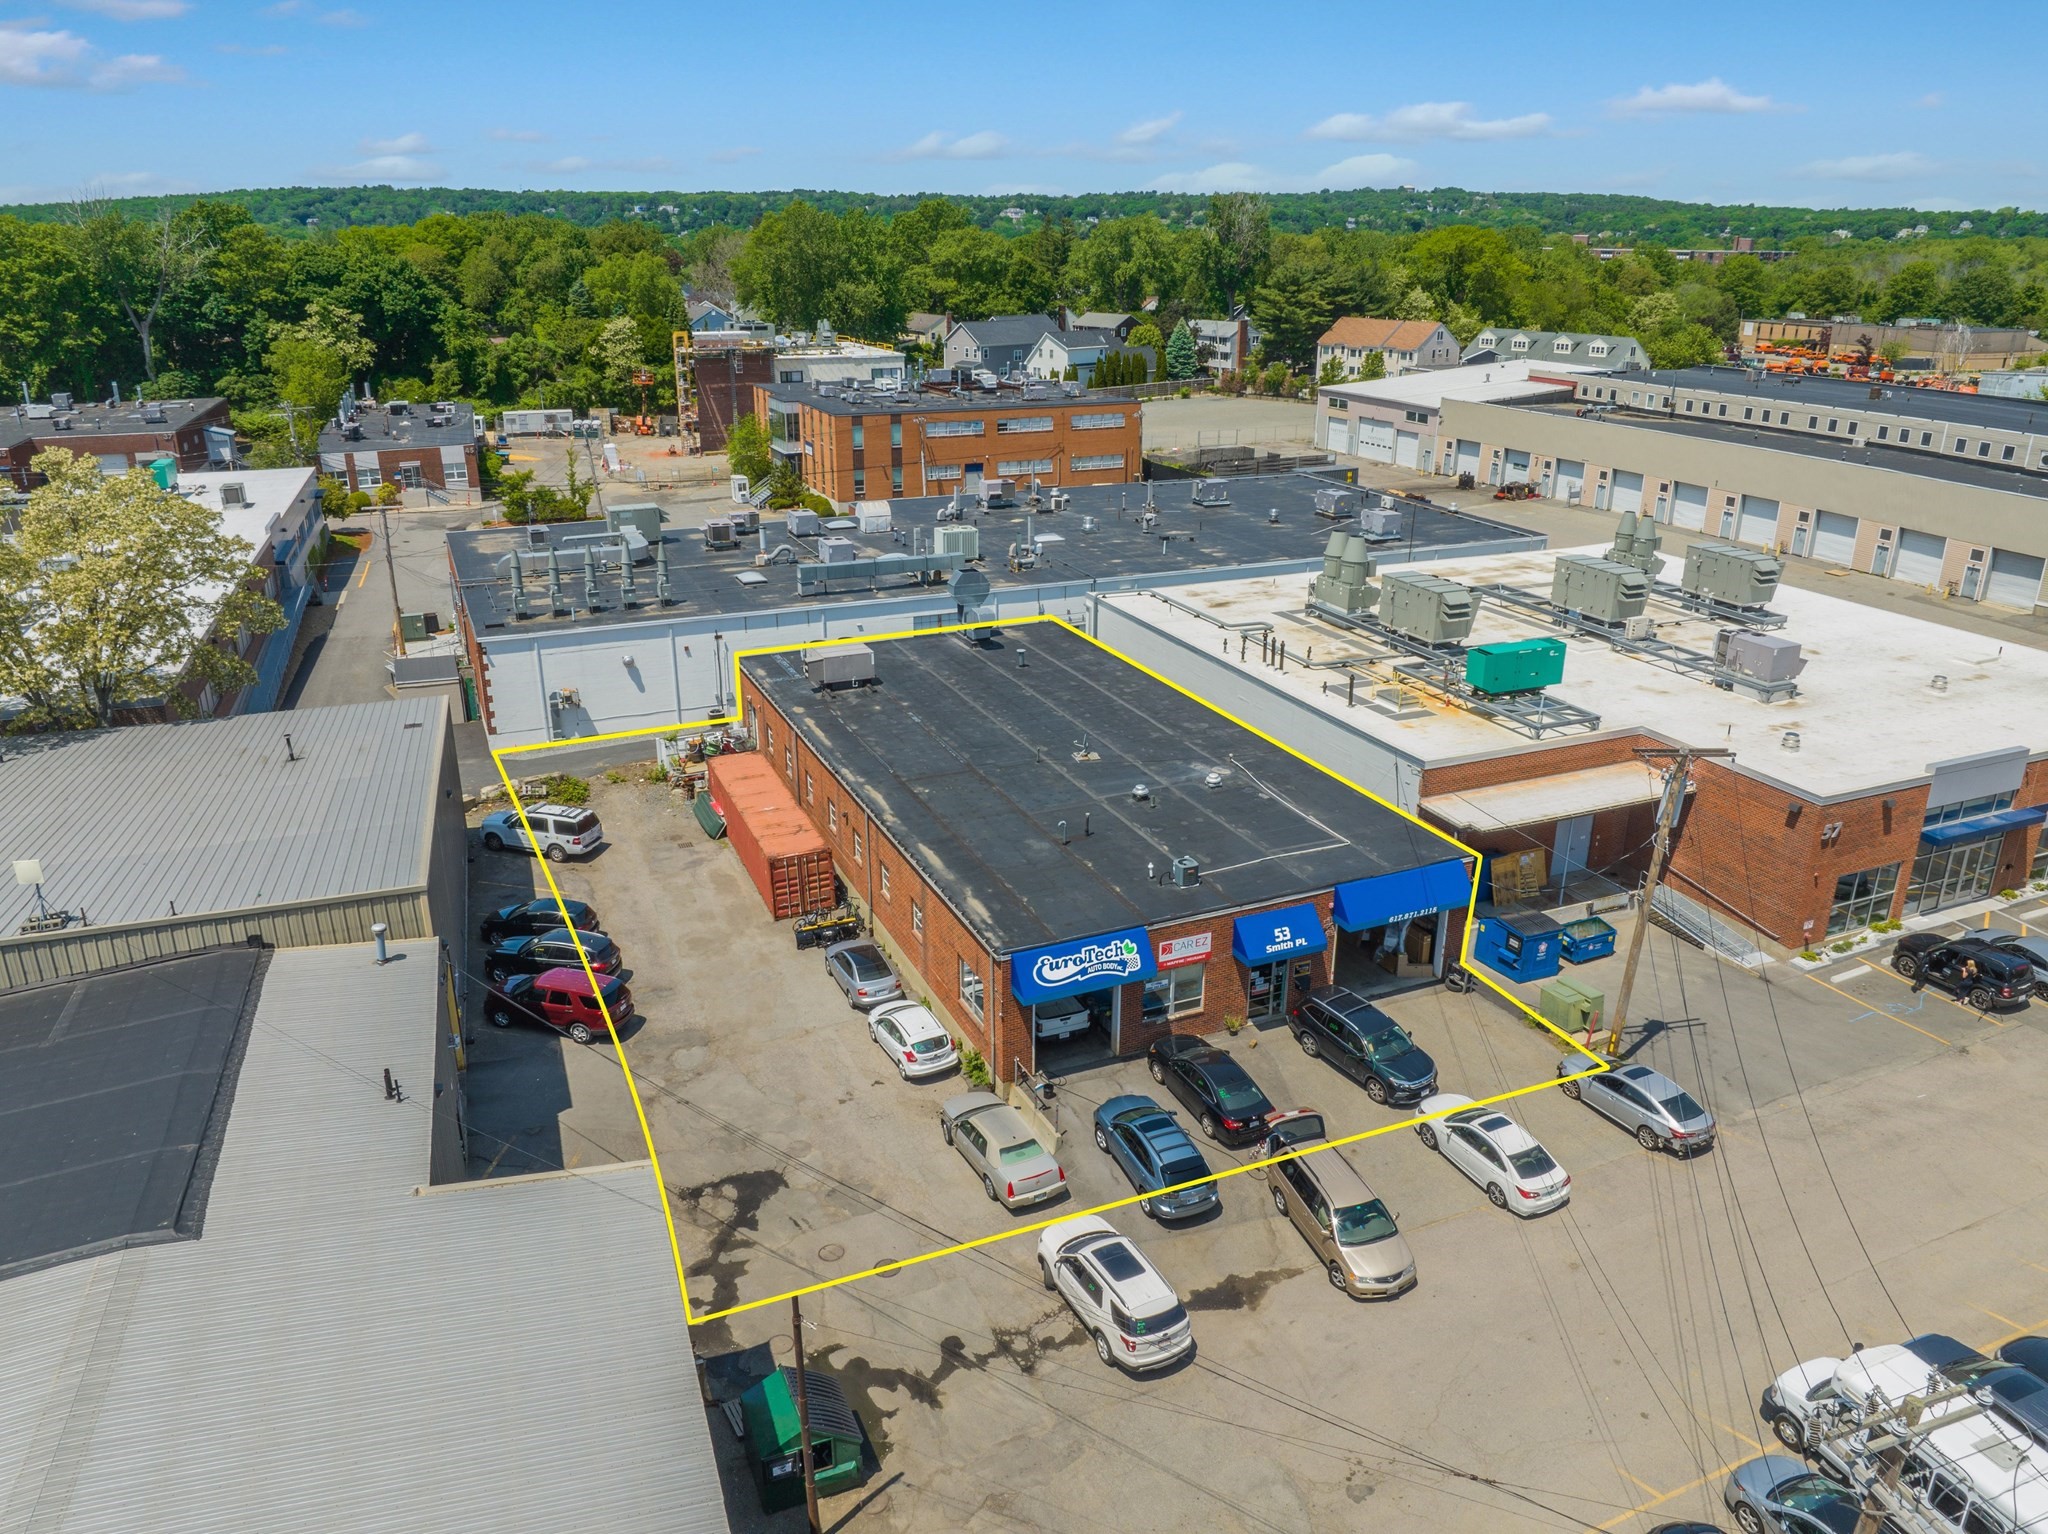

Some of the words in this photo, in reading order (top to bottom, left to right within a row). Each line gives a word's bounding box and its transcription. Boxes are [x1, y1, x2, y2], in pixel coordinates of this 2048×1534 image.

[1821, 822, 1844, 840] 57
[1274, 926, 1291, 942] 53
[1174, 939, 1194, 952] CAR
[1195, 936, 1208, 947] EZ
[1266, 941, 1294, 953] Smith
[1295, 938, 1308, 947] PL
[1038, 942, 1125, 972] EuroTech
[1087, 964, 1102, 974] AUTO
[1103, 962, 1117, 971] BODY
